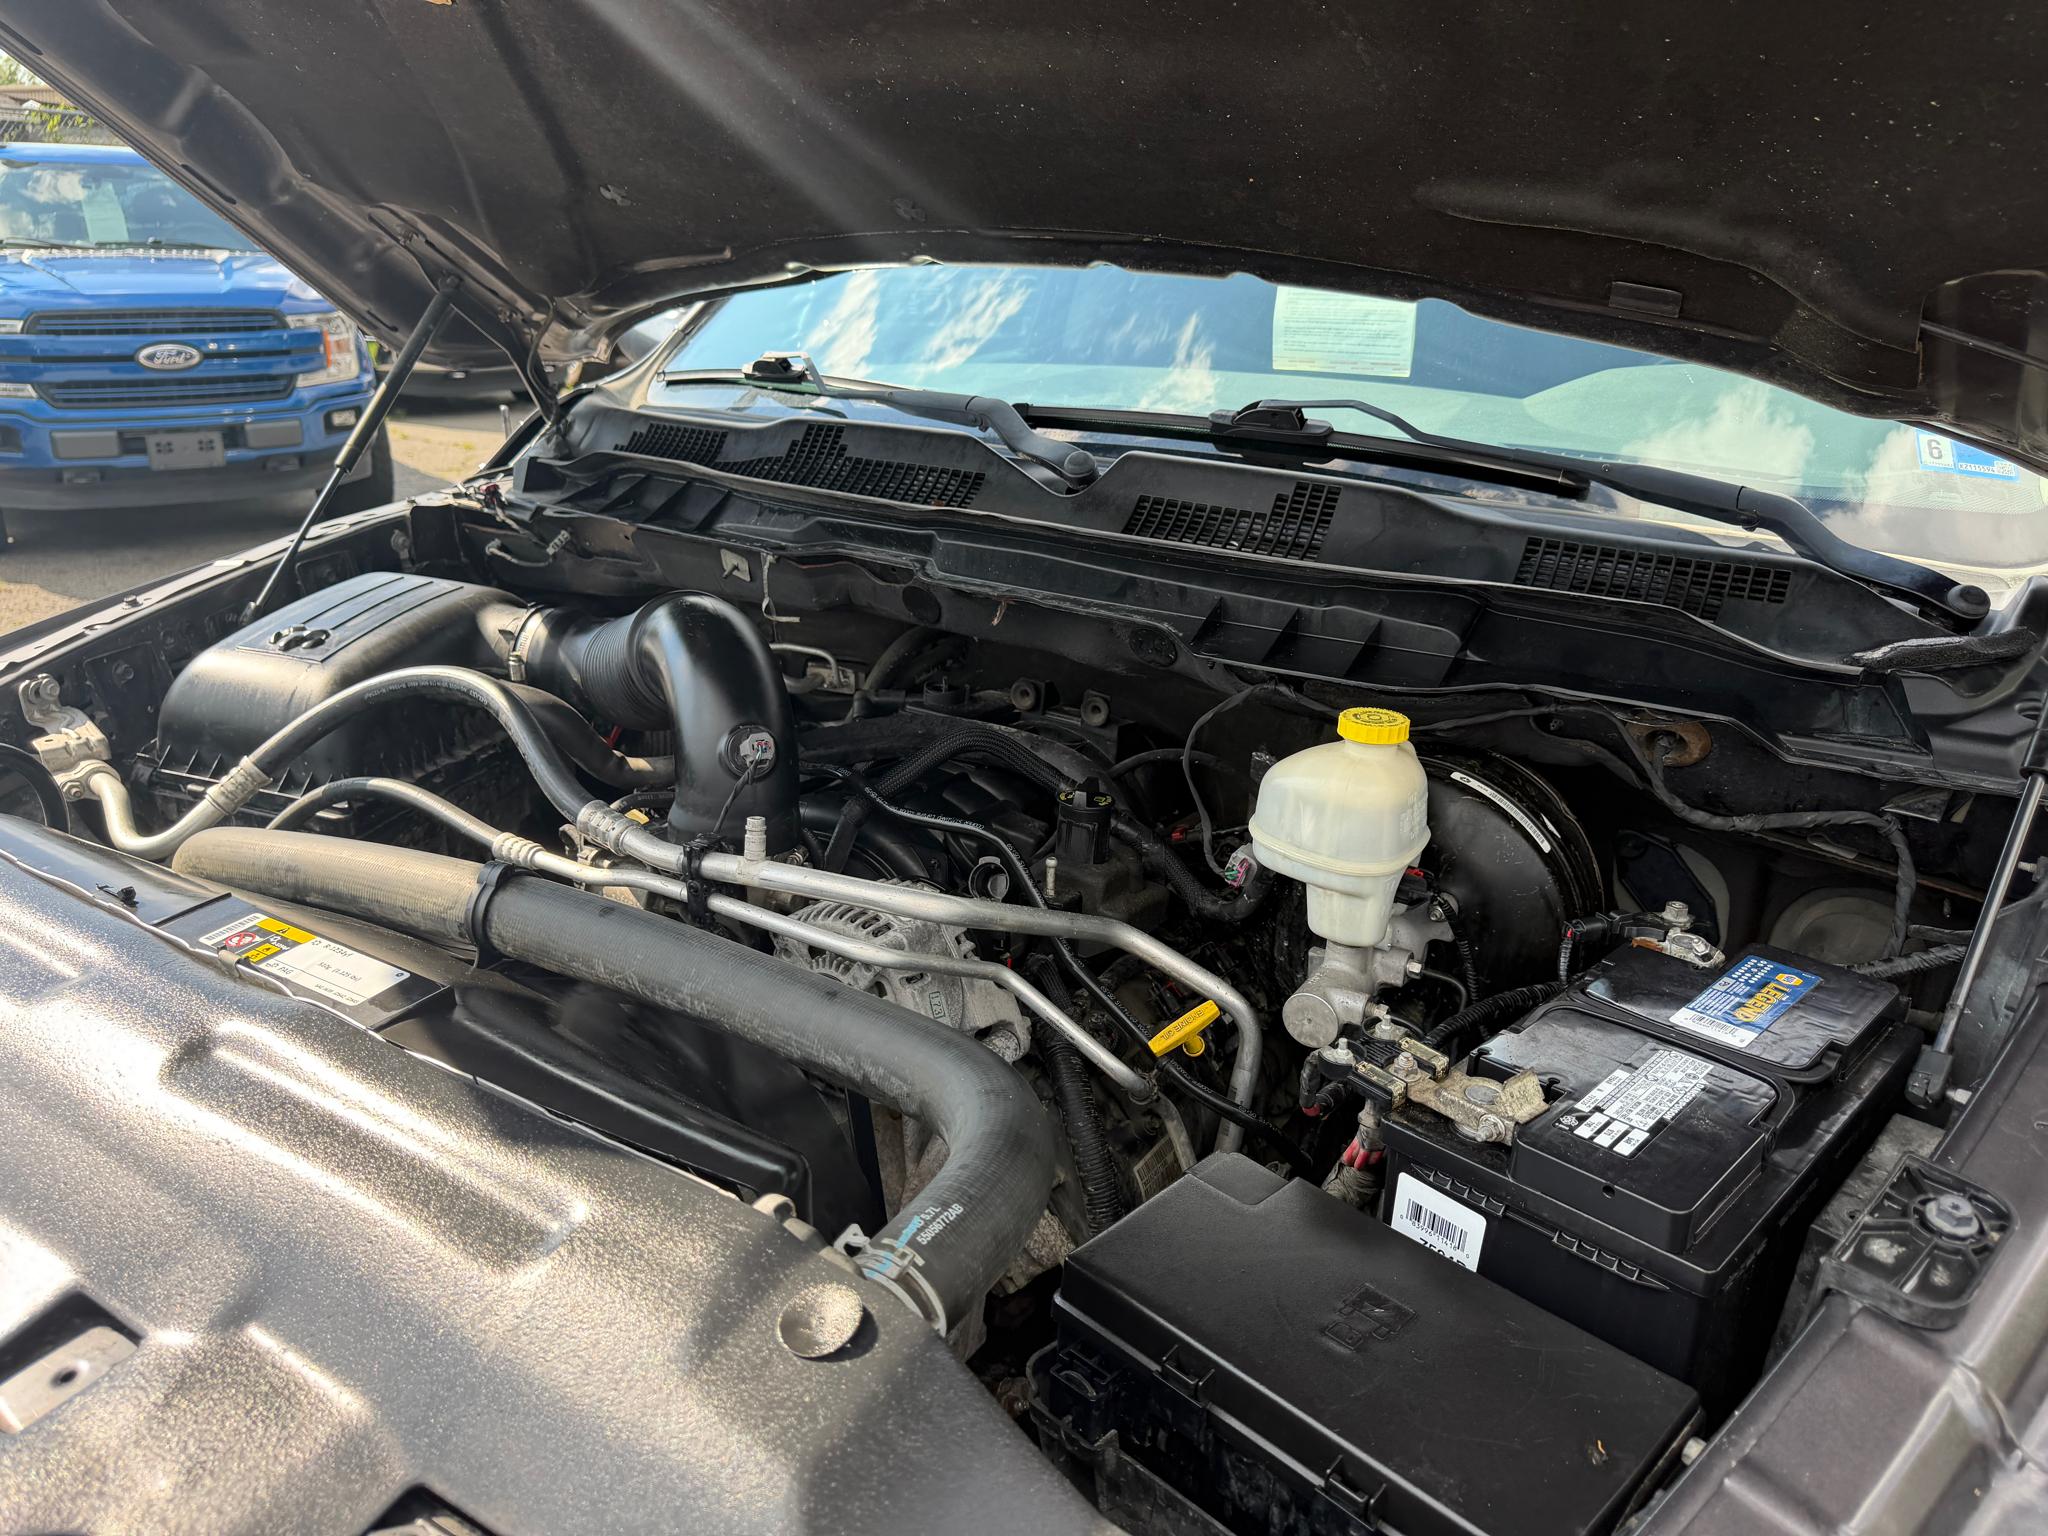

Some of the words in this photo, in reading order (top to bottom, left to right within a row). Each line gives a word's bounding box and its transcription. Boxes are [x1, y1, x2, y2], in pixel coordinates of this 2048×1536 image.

[152, 349, 186, 365] Ford
[1926, 438, 1943, 460] 6
[1733, 982, 1792, 1023] LEGEND
[1174, 1009, 1205, 1032] ENGINE
[1160, 1030, 1174, 1041] OIL
[915, 1202, 965, 1245] 55056772AB
[921, 1204, 942, 1221] 5.7L
